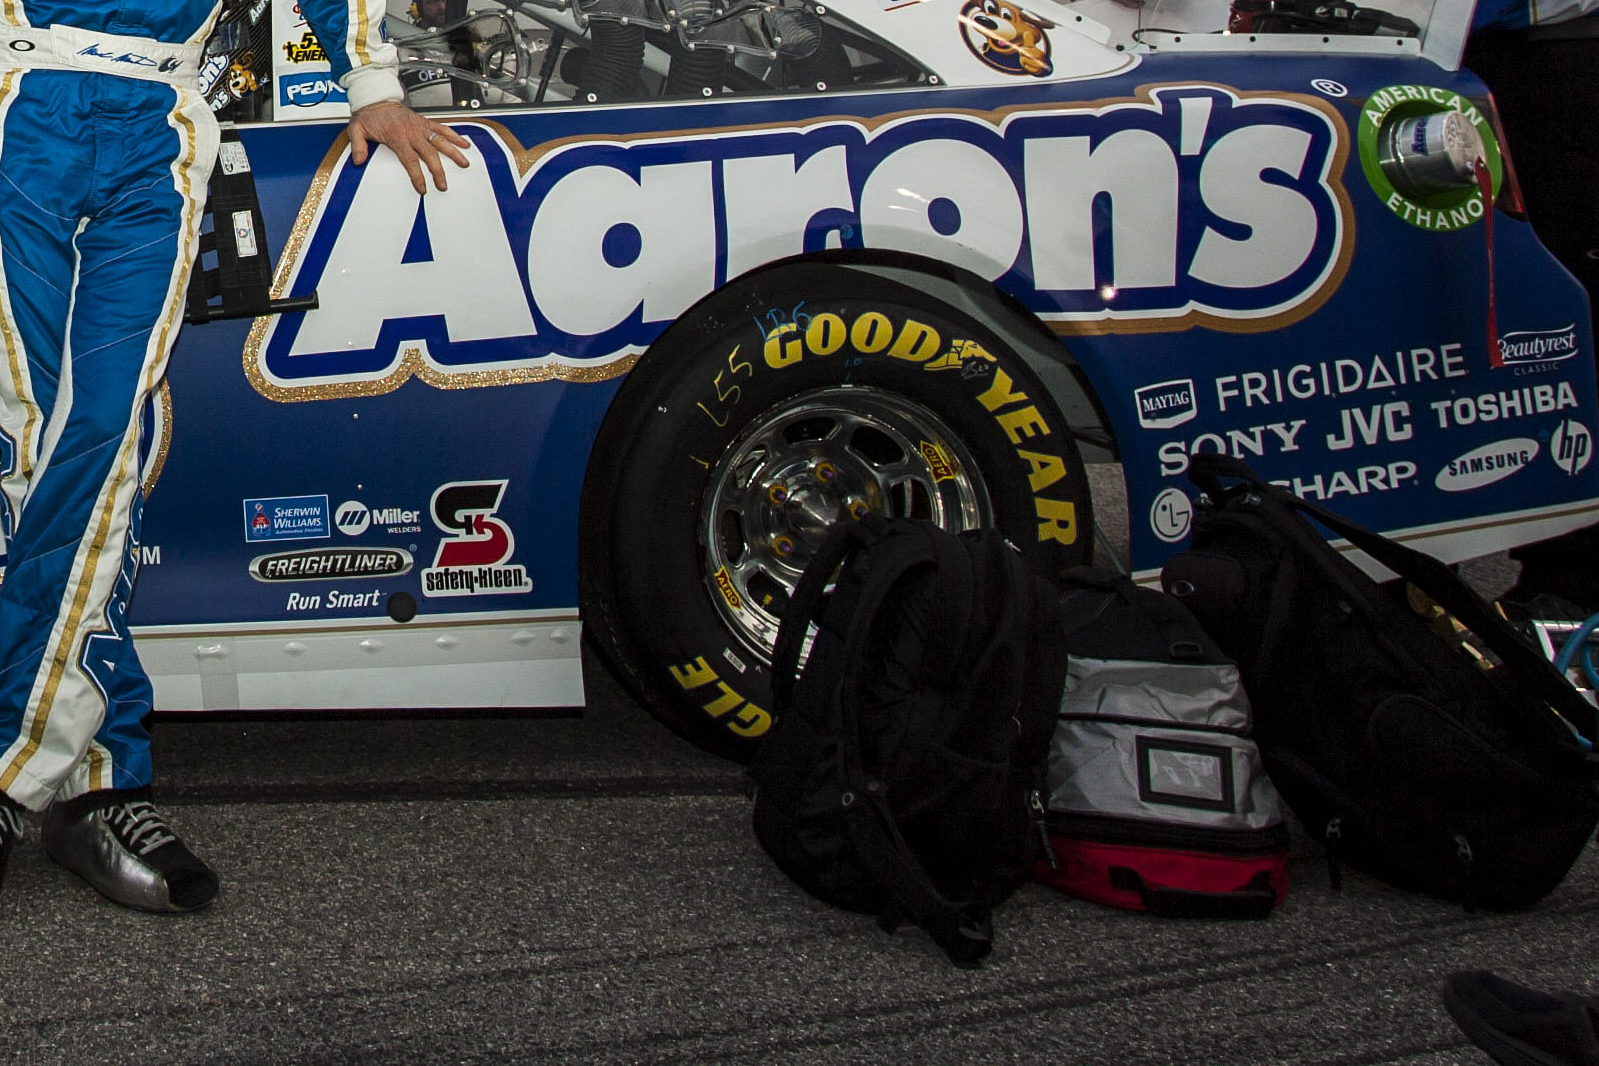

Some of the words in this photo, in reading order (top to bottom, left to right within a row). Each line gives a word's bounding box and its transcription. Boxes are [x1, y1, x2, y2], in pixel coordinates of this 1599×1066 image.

[1365, 85, 1484, 127] AMERICAN
[1386, 191, 1485, 230] ETHANO
[266, 89, 1337, 382] Aaron's
[1215, 343, 1469, 412] FRIGIDAIRE
[1513, 362, 1561, 376] CLASSIC
[1142, 390, 1191, 412] MAYTAG
[1431, 381, 1579, 428] TOSHIBA
[763, 310, 1077, 546] GOODYEAR
[1327, 401, 1413, 450] JVC
[1158, 420, 1307, 476] SONY
[1447, 449, 1530, 477] SAMSUNG
[1551, 419, 1591, 476] hp
[1263, 461, 1418, 501] HARP
[274, 507, 321, 517] SHERWIN
[274, 517, 322, 528] WILLIAMS
[373, 509, 419, 525] Miller
[387, 526, 421, 534] WELDERS
[266, 555, 397, 577] FREIGHTLINER
[287, 592, 320, 611] Run
[326, 589, 380, 608] Smart
[717, 576, 739, 605] AERO
